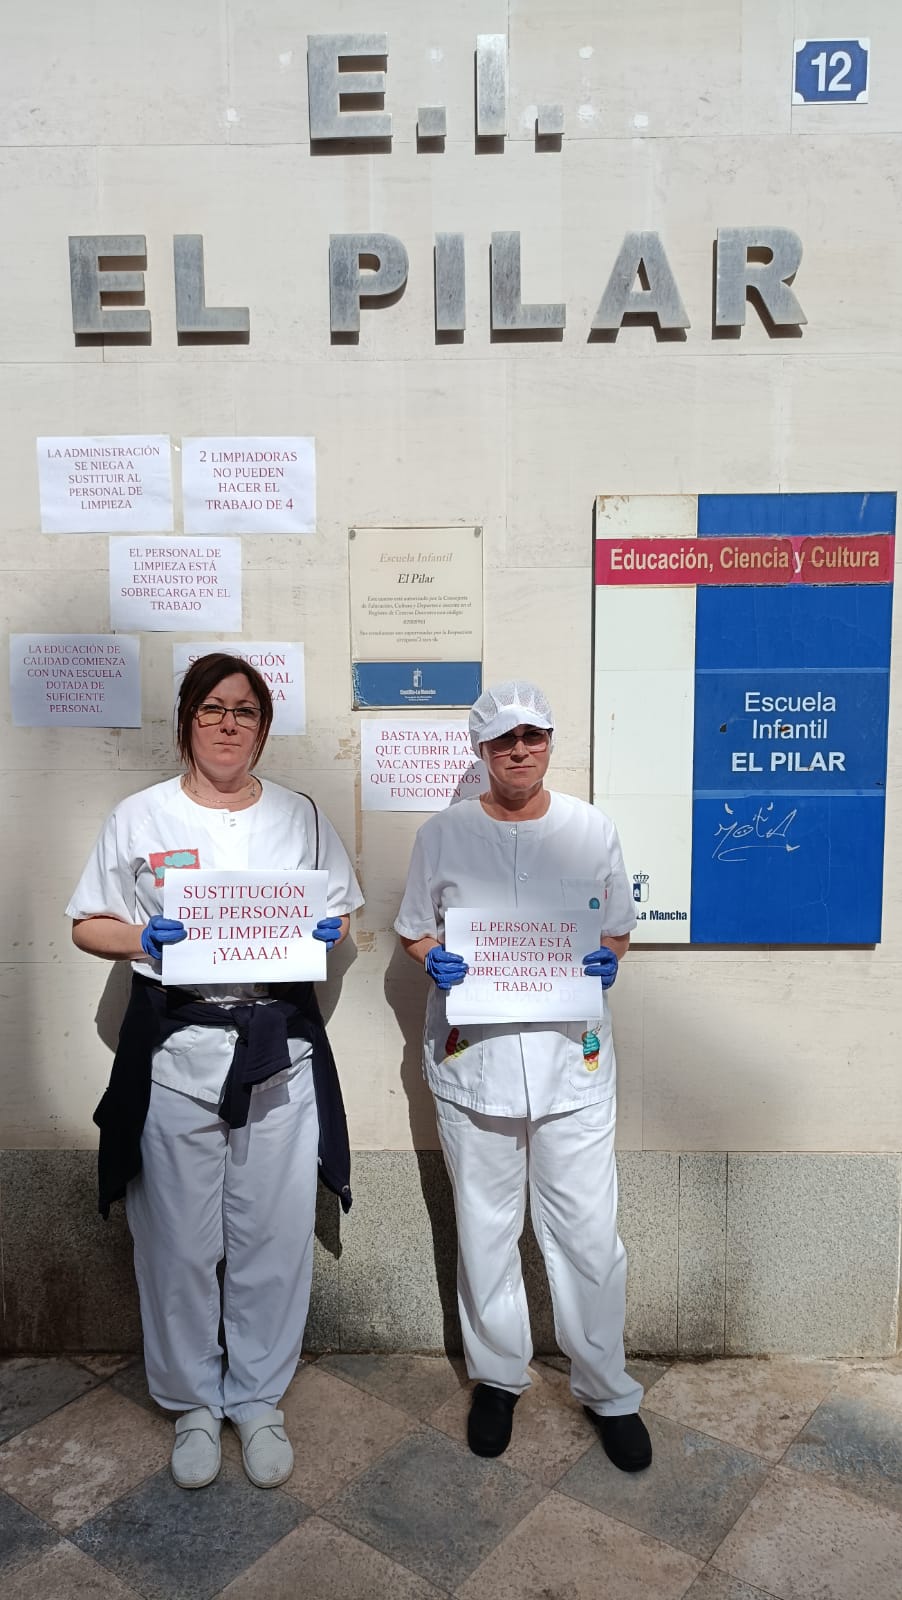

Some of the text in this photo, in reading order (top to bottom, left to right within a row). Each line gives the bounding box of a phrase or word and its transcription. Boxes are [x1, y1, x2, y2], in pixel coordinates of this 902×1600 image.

[811, 50, 852, 92] 12
[68, 226, 808, 334] EL PILAR
[47, 445, 160, 458] LA ADMINISTRACIÓN
[199, 450, 298, 463] 2 LIMPIADORAS
[75, 460, 135, 471] SE NIEGA A
[213, 467, 285, 478] NO PUEDEN
[68, 473, 142, 484] SUSTITUIR AL
[69, 486, 143, 497] PERSONAL DE
[218, 482, 280, 493] HACER EL
[81, 499, 133, 510] LIMPIEZA
[205, 498, 294, 510] TRABAJO DE 4
[129, 548, 222, 558] EL PERSONAL DE
[380, 552, 453, 563] Escuela Infantil
[610, 545, 880, 574] Educación, Ciencia y Cultura
[134, 560, 217, 571] LIMPIEZA ESTÁ
[133, 574, 218, 585] EXHAUSTO POR
[398, 573, 435, 584] El Pilar
[121, 587, 231, 598] SOBRECARGA EN EL
[151, 601, 202, 611] TRABAJO
[28, 644, 121, 654] LA EDUCACIÓN DE
[23, 657, 126, 666] CALIDAD COMIENZA
[27, 669, 122, 678] CON UNA ESCUELA
[46, 681, 105, 690] DOTADA DE
[46, 692, 105, 702] SUFICIENTE
[745, 691, 837, 713] Escuela
[49, 704, 103, 713] PERSONAL
[752, 718, 829, 740] Infantil
[381, 730, 470, 742] BASTA YA, HAY
[375, 745, 475, 756] QUE CUBRIR LAS
[376, 759, 476, 770] VACANTES PARA
[731, 751, 847, 772] EL PILAR
[370, 773, 481, 784] QUE LOS CENTROS
[390, 787, 462, 798] FUNCIONEN
[183, 882, 306, 900] SUSTITUCIÓN
[178, 905, 313, 920] DEL PERSONAL
[650, 910, 688, 920] Mancha
[471, 921, 578, 933] EL PERSONAL DE
[188, 925, 303, 941] DE LIMPIEZA
[476, 935, 572, 948] LIMPIEZA ESTÁ
[212, 946, 288, 965] ¡YAAAA!
[474, 951, 573, 962] EXHAUSTO POR
[467, 966, 586, 977] OBRECARGA EN EL
[493, 981, 553, 992] TRABAJO
